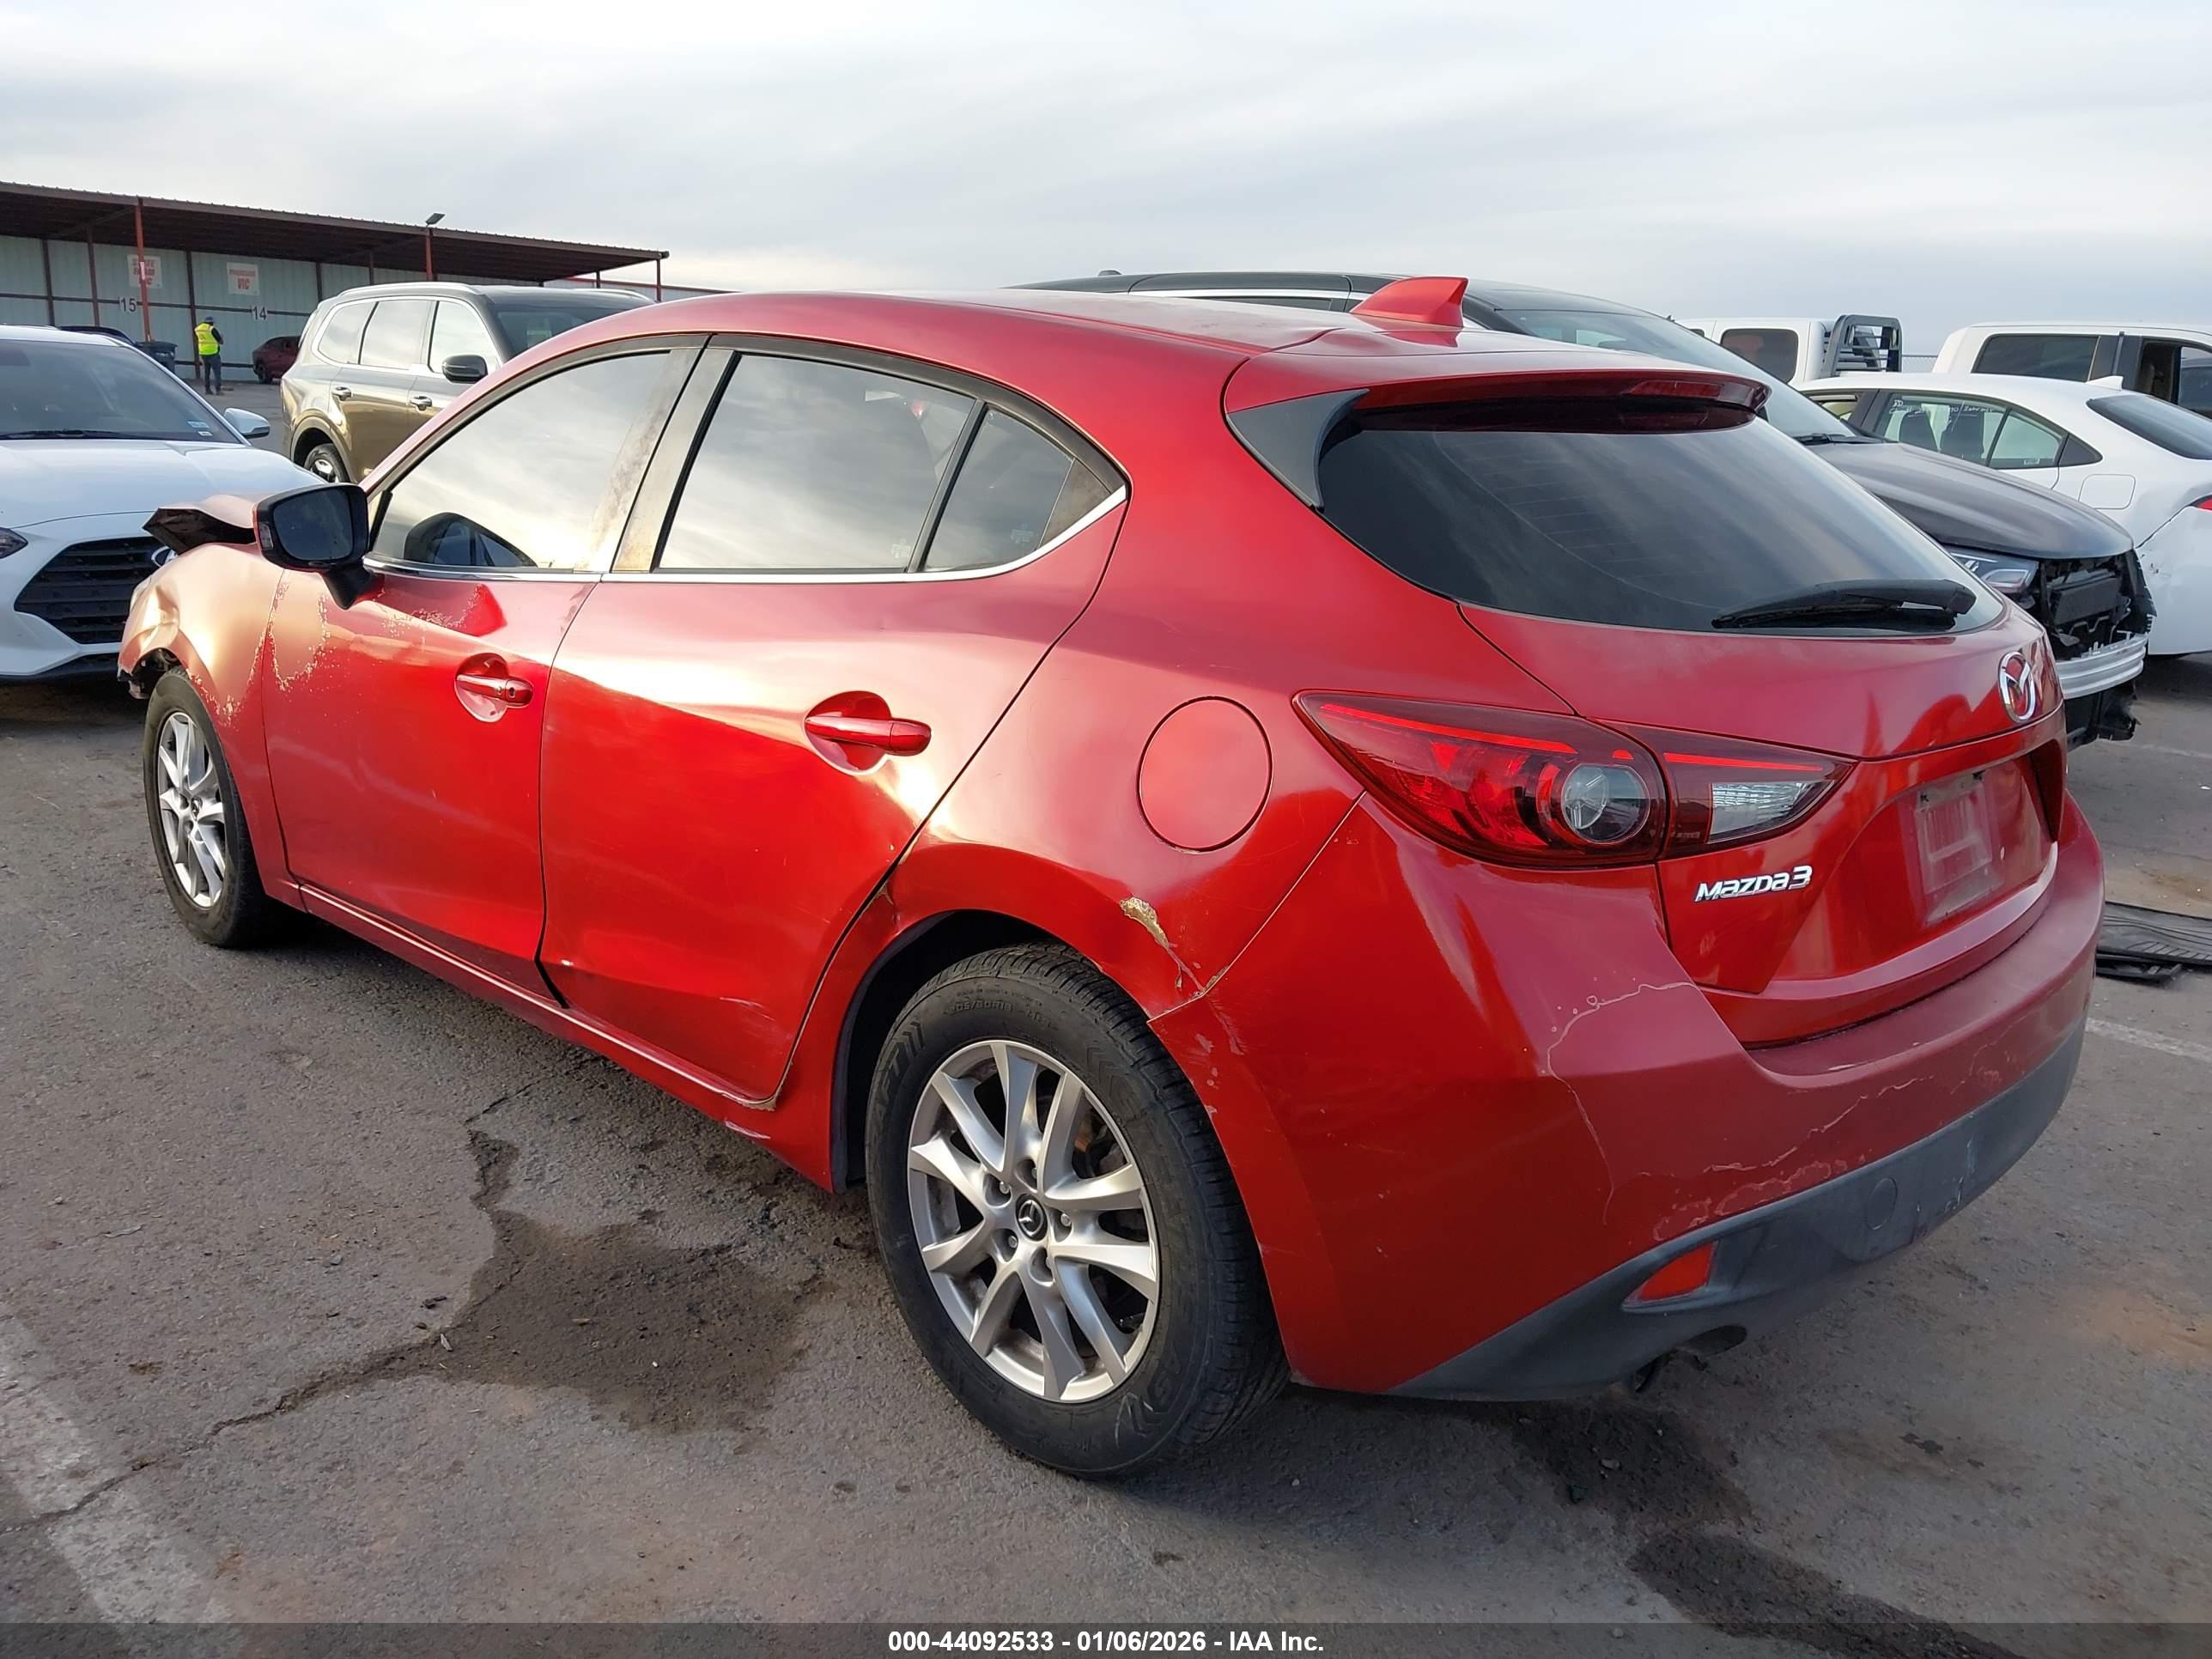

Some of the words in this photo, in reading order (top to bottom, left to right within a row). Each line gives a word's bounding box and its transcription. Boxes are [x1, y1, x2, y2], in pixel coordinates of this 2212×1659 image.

[237, 277, 250, 289] VIC
[121, 298, 137, 313] 15
[252, 306, 267, 320] 14
